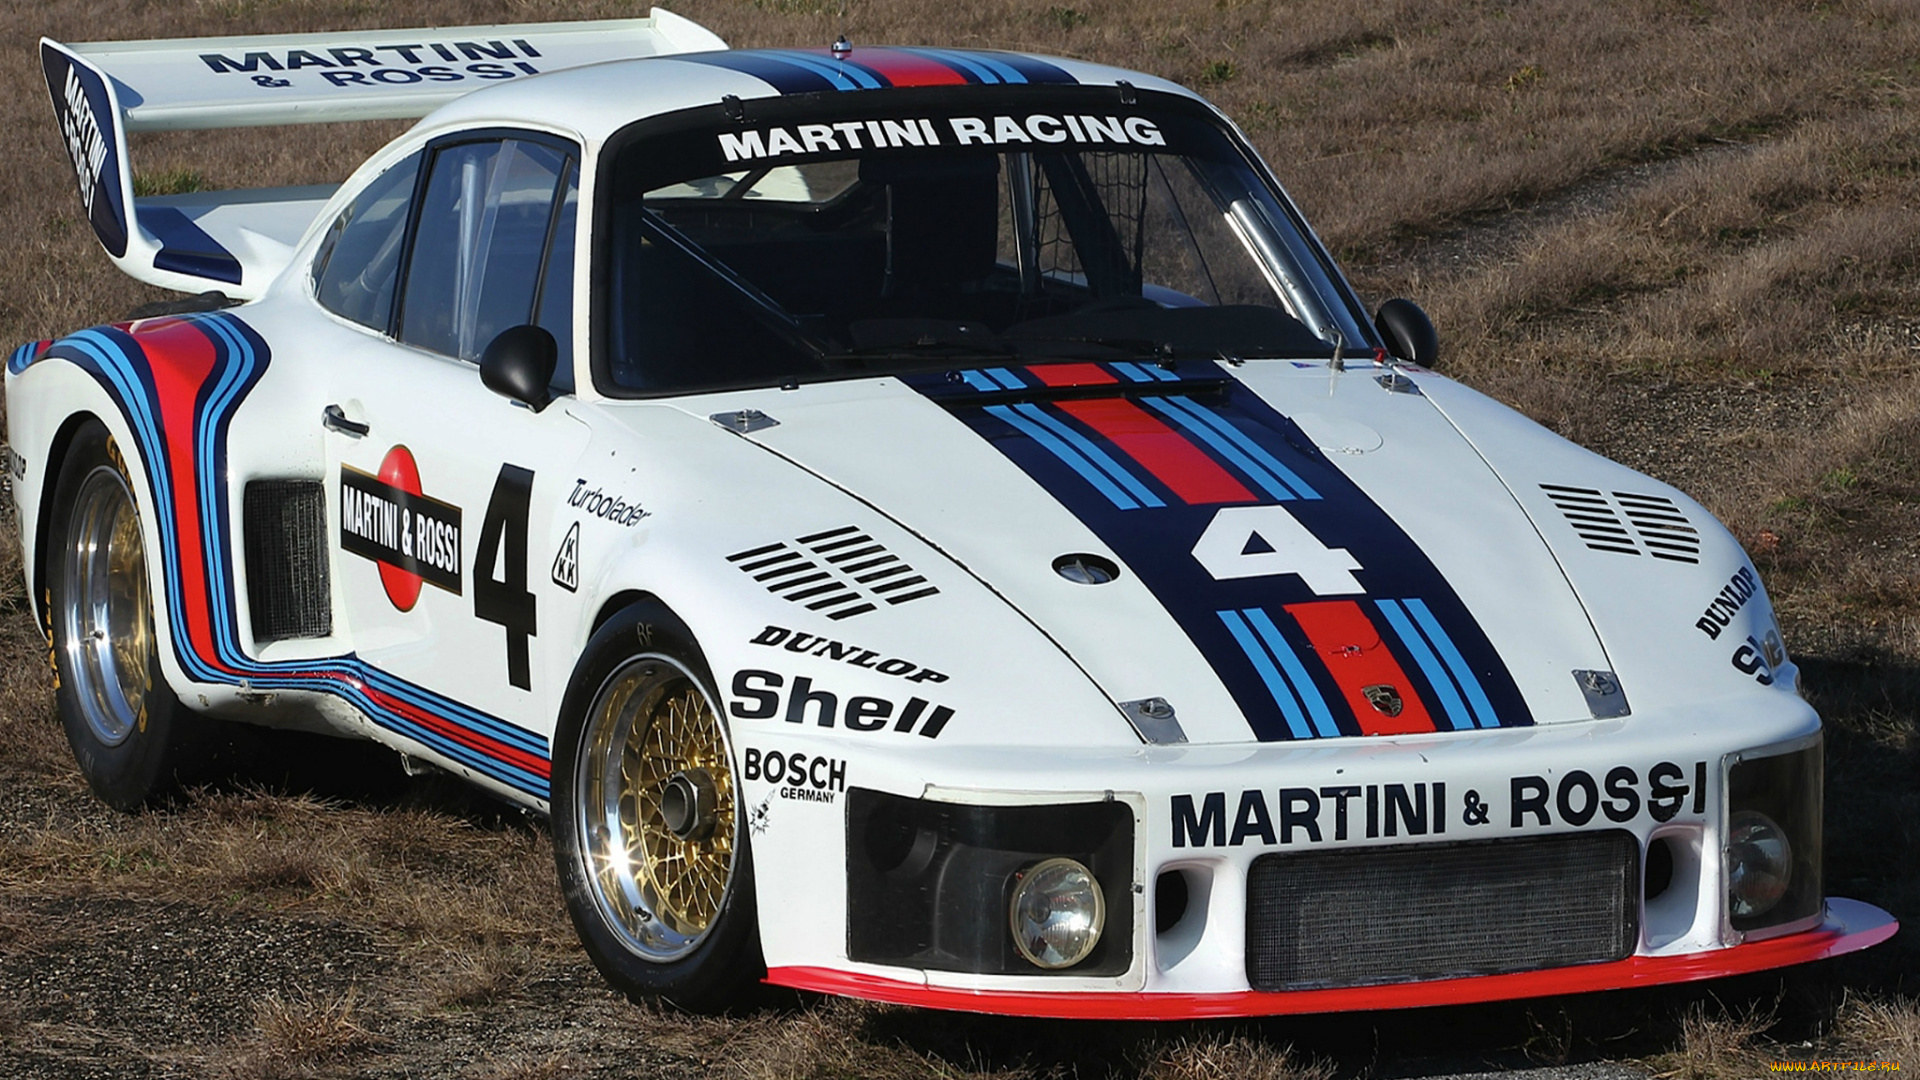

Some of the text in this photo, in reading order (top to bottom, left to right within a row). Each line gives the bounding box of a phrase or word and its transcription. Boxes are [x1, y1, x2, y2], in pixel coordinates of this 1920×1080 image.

[198, 38, 542, 73] MARTINI
[251, 62, 540, 88] & ROSSI
[64, 62, 108, 184] MARTINI
[718, 114, 1166, 162] MARTINI RACING
[343, 484, 459, 575] MARTINI & ROSSI
[566, 478, 653, 527] Turbolader
[473, 462, 537, 692] 4
[1190, 504, 1368, 597] 4
[1695, 566, 1757, 640] DUNLOP
[749, 625, 951, 684] DUNLOP
[730, 669, 957, 740] Shell
[744, 747, 847, 793] BOSCH
[780, 786, 836, 804] GERMANY
[1170, 761, 1708, 848] MARTINI & ROSSI
